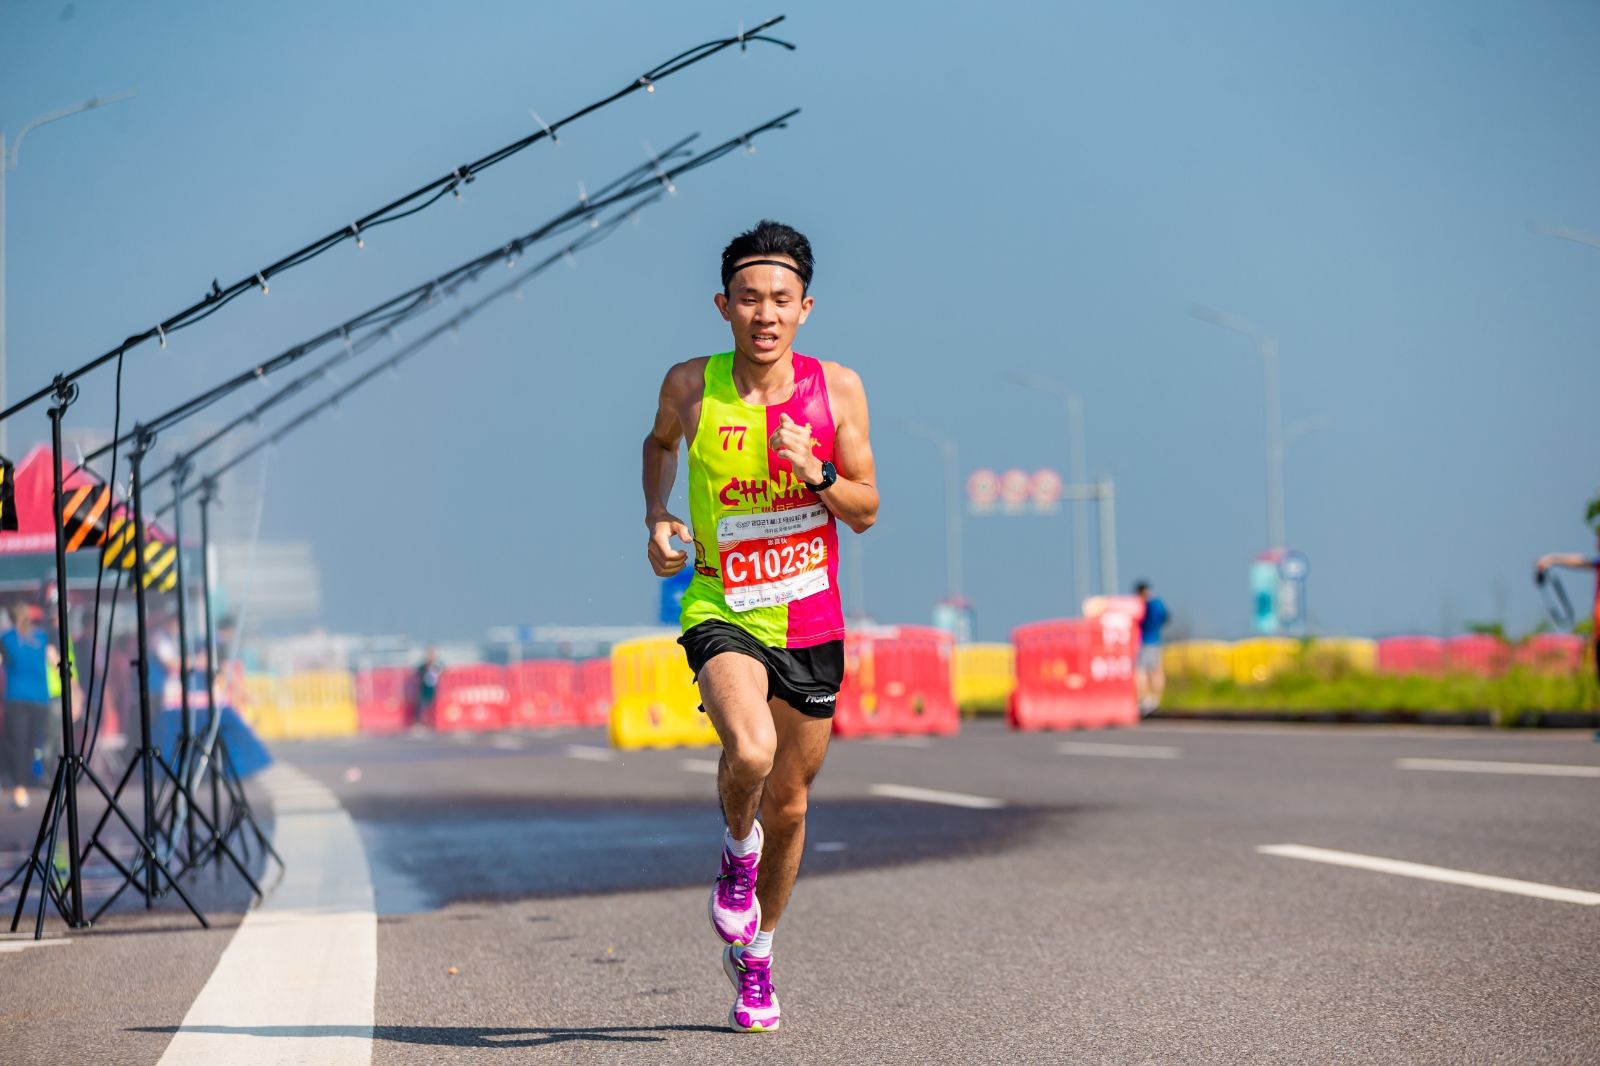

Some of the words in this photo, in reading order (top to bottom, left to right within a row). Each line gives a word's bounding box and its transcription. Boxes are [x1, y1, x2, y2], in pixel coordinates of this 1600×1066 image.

[719, 426, 747, 451] 77
[719, 470, 807, 506] CHINA
[726, 537, 824, 582] C10239
